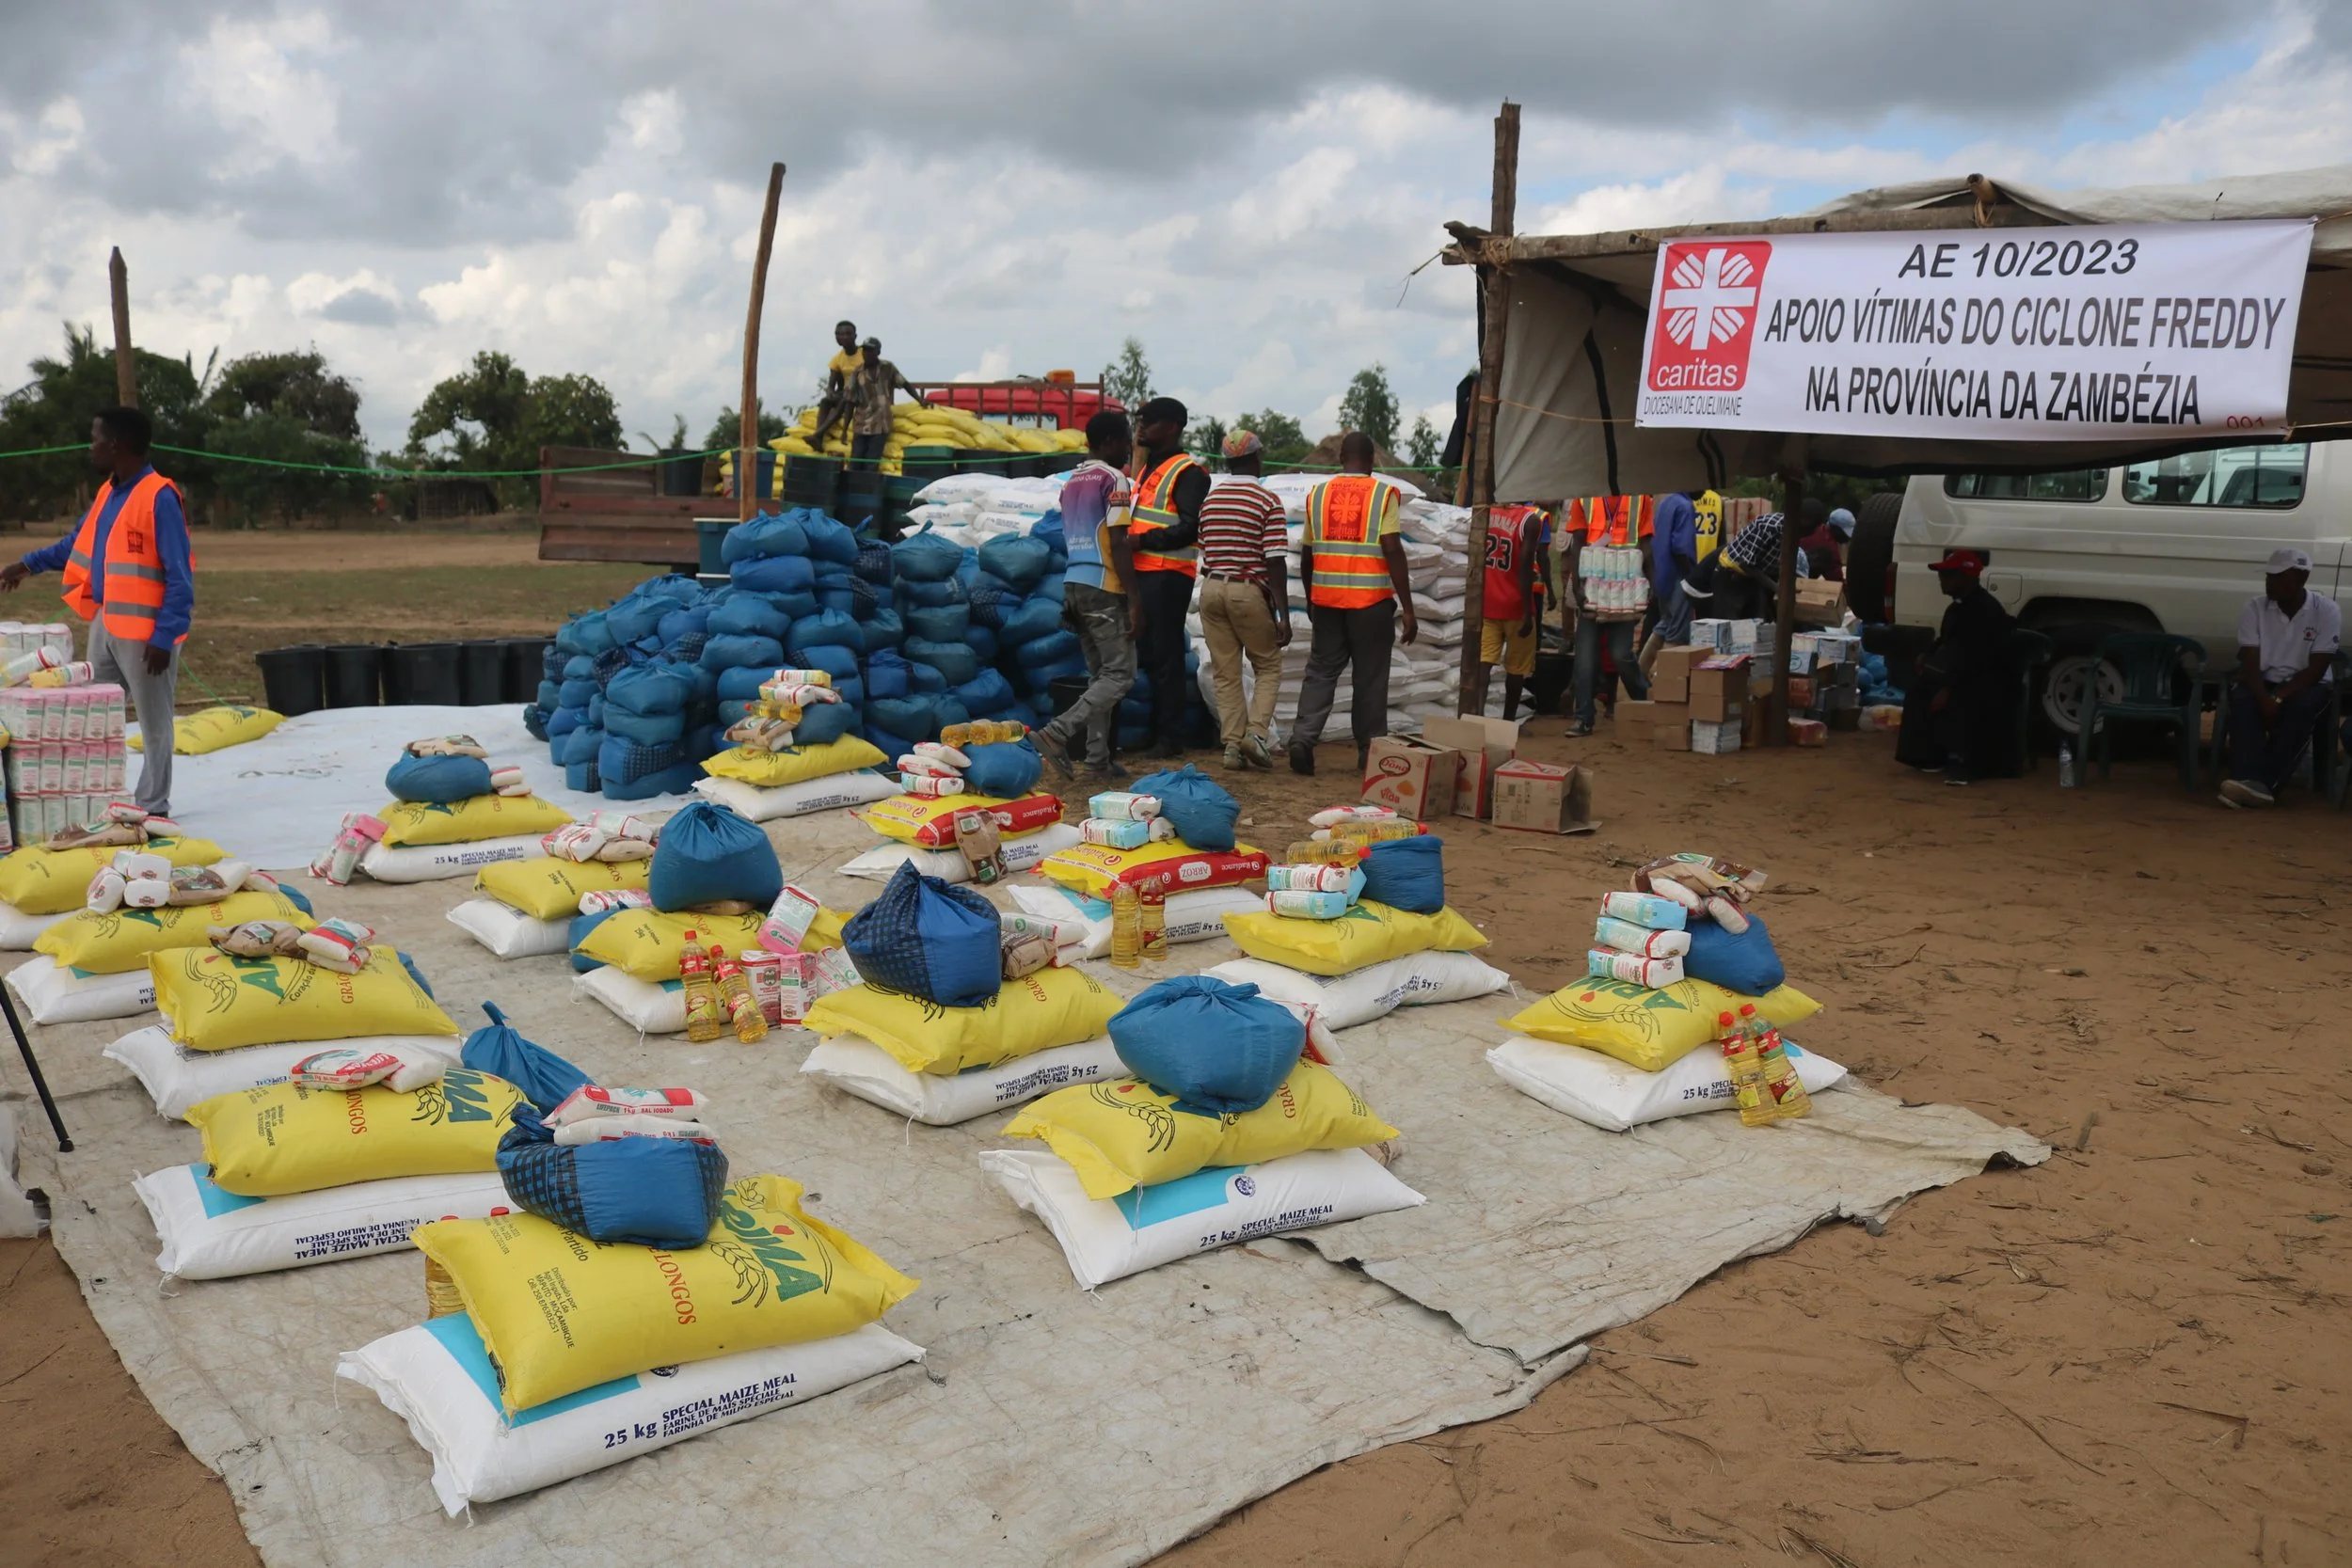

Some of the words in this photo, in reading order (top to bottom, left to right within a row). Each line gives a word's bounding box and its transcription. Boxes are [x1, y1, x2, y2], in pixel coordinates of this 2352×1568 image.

[1899, 244, 1960, 278] AE
[1972, 239, 2139, 278] 10/2023
[1764, 297, 1845, 342] APOIO
[1853, 288, 1956, 345] VÍTIMAS
[1962, 297, 2004, 346] DO
[2011, 296, 2144, 347] CICLONE
[2149, 297, 2286, 350] FREDDY
[1657, 357, 1738, 388] caritas
[1805, 366, 1840, 413] NA
[1847, 356, 1992, 418] PROVÍNCIA
[2000, 371, 2039, 420] DA
[2045, 361, 2201, 425] ZAMBÉZIA
[1644, 395, 1683, 415] DIOCESANA
[1684, 396, 1693, 415] DE
[1695, 396, 1742, 416] QUELIMANE
[2226, 415, 2265, 429] 001
[1694, 512, 1718, 535] 23
[1486, 533, 1513, 572] 23
[1181, 865, 1209, 878] ARROZ
[1072, 1066, 1083, 1077] kg
[1086, 1065, 1099, 1075] 25
[1682, 1088, 1695, 1100] 25
[1697, 1085, 1708, 1099] kg
[1241, 1216, 1277, 1232] SPECIAL
[1279, 1208, 1308, 1221] MAIZE
[1309, 1204, 1334, 1216] MEAL
[295, 1231, 335, 1245] ESPECIAL
[338, 1227, 367, 1237] MILHO
[375, 1233, 413, 1247] PECIAL
[1200, 1234, 1216, 1247] 25
[1220, 1229, 1236, 1242] kg
[294, 1246, 327, 1259] MEAL
[332, 1239, 370, 1254] MAIZE
[564, 1230, 588, 1261] Partido
[654, 1252, 697, 1325] LONGOS
[535, 1274, 551, 1297] MAPUTO
[549, 1300, 576, 1349] MOÇAMBIQUE
[662, 1397, 715, 1422] SPECIAL
[719, 1384, 759, 1404] MAIZE
[763, 1372, 798, 1392] MEAL
[663, 1418, 705, 1437] FARINHA
[706, 1413, 719, 1423] DE
[721, 1404, 754, 1418] MILHO
[754, 1390, 795, 1408] ESPECIAL
[663, 1413, 696, 1431] FARINE
[698, 1408, 709, 1418] DE
[604, 1429, 627, 1449] 25
[634, 1421, 657, 1439] kg
